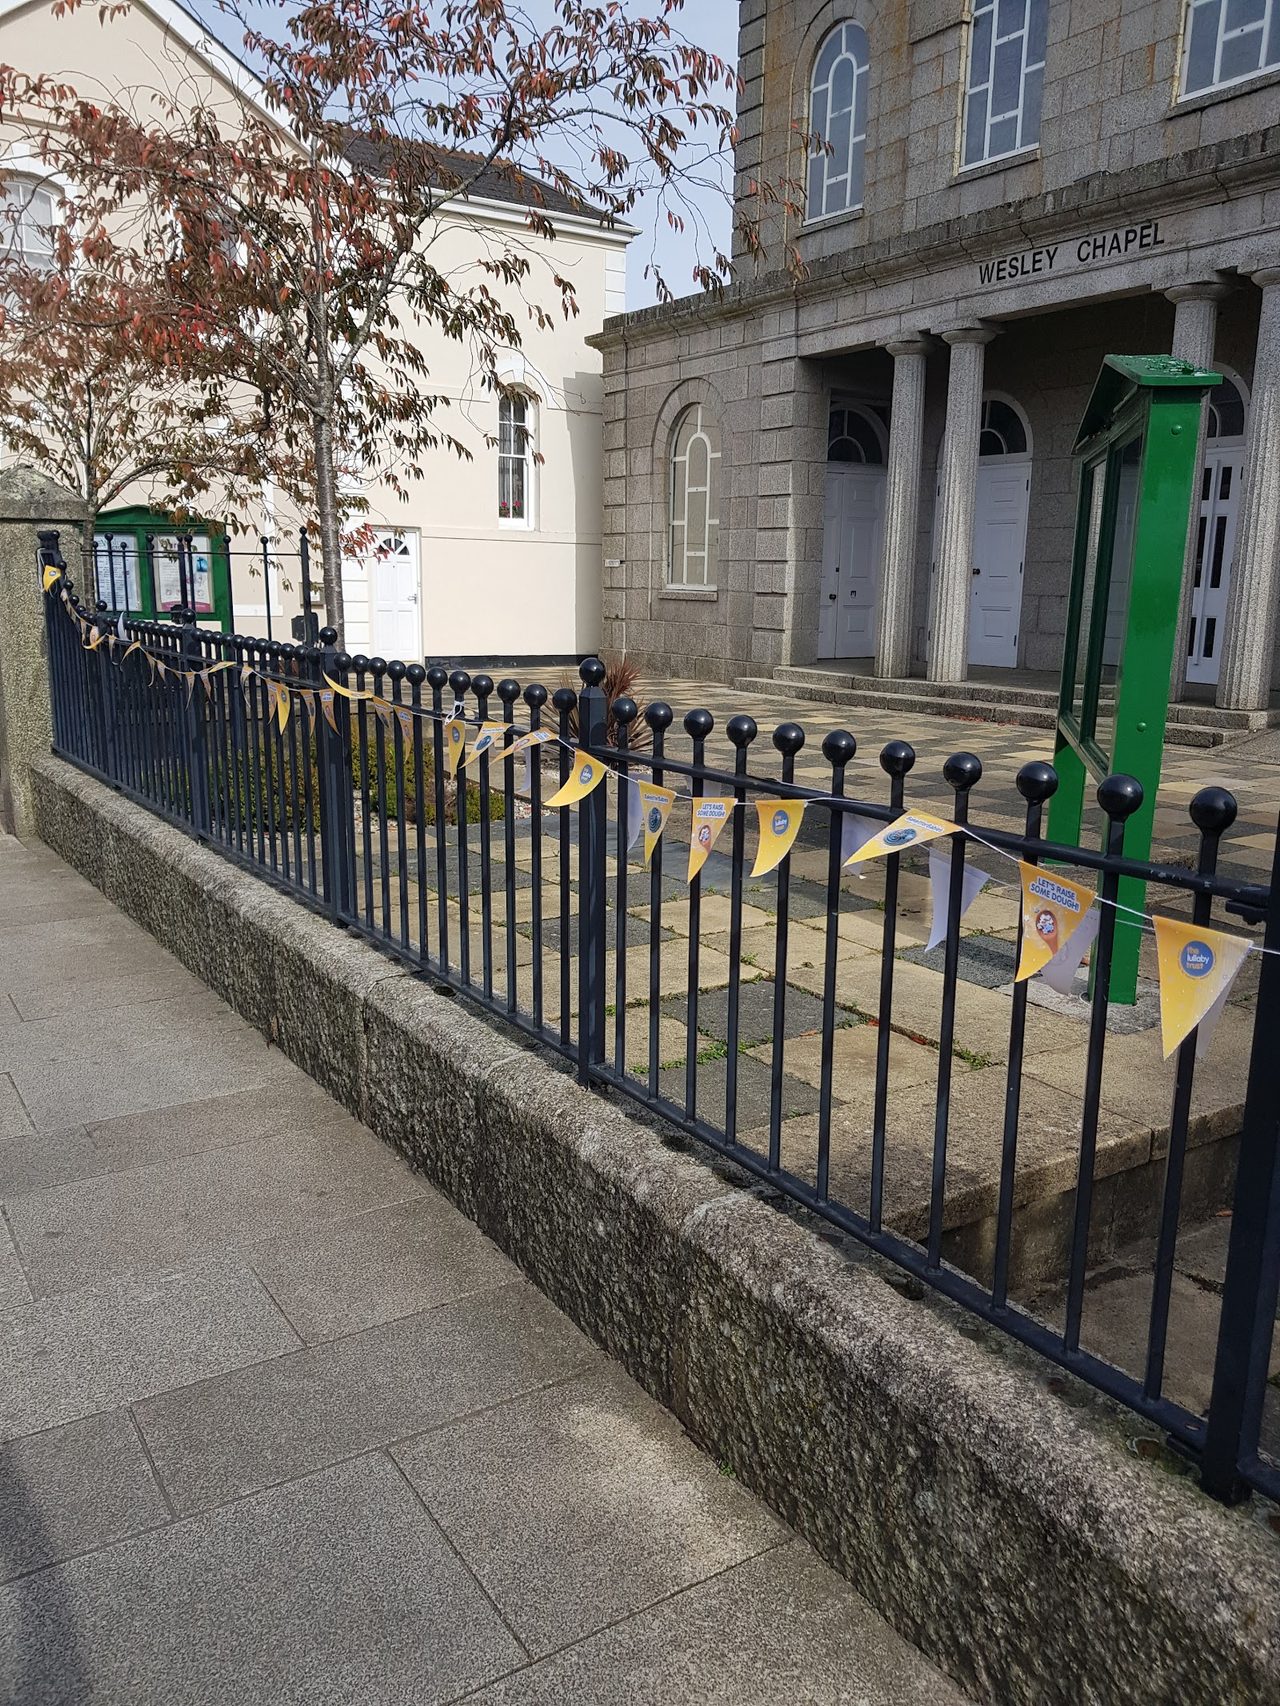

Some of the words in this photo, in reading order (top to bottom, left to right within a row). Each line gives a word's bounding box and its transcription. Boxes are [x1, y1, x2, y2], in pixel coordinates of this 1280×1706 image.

[979, 247, 1058, 284] WESLEY
[1077, 223, 1164, 262] CHAPEL
[1030, 883, 1051, 899] SOME
[1051, 892, 1080, 912] DOUGH!
[1038, 877, 1056, 891] LET'S
[1056, 885, 1076, 901] RAISE
